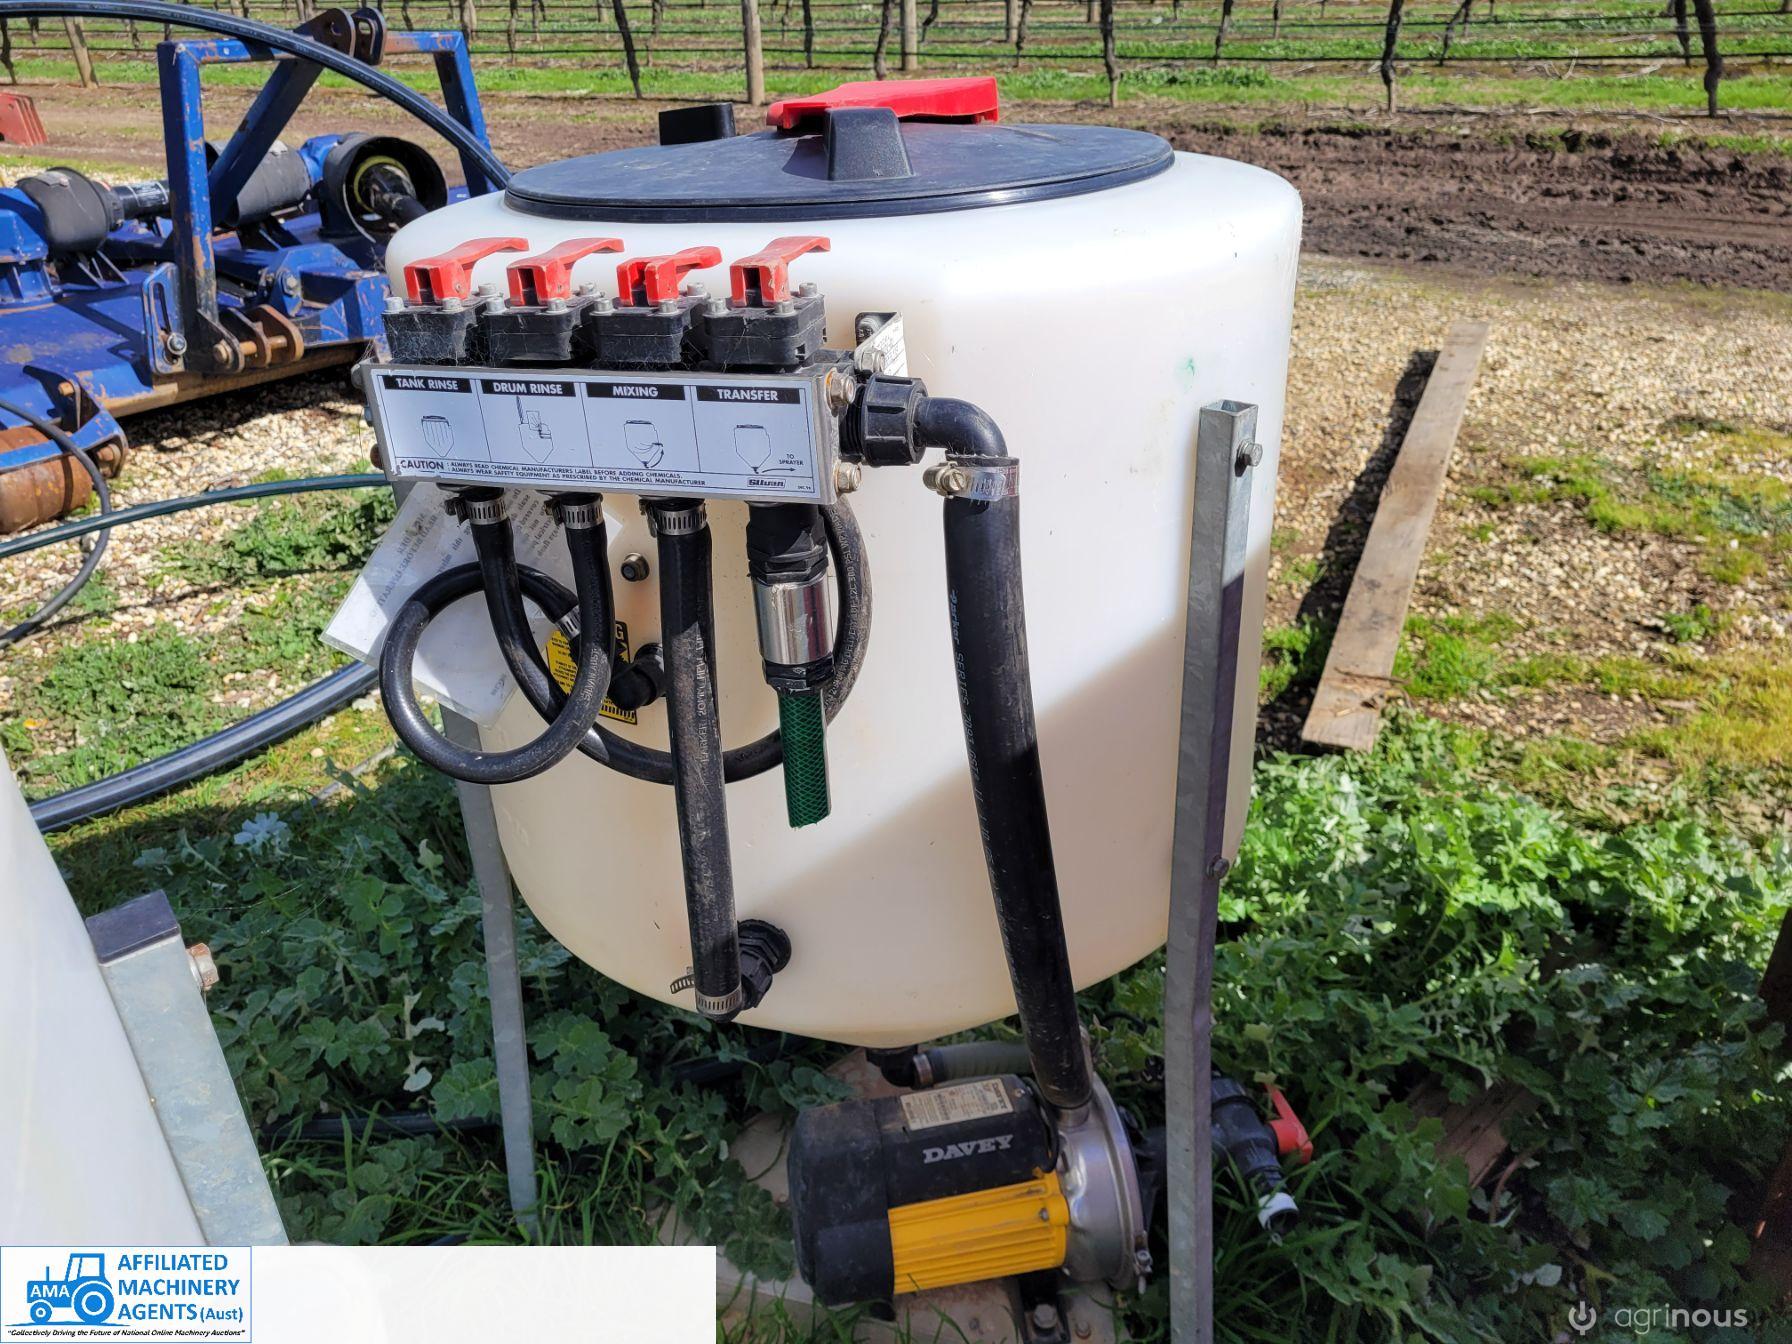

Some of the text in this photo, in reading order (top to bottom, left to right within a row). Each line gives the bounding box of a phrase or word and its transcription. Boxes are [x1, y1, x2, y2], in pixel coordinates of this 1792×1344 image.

[395, 377, 459, 391] TANK RINSE
[493, 381, 563, 395] DRUM RINSE
[612, 385, 659, 397] MIXING
[717, 388, 778, 401] TRANSFER
[400, 459, 445, 470] CAUTION
[521, 465, 573, 474] MANUFACTURERS
[654, 478, 706, 486] MANUFACTURER
[922, 1134, 1014, 1164] DAVEY
